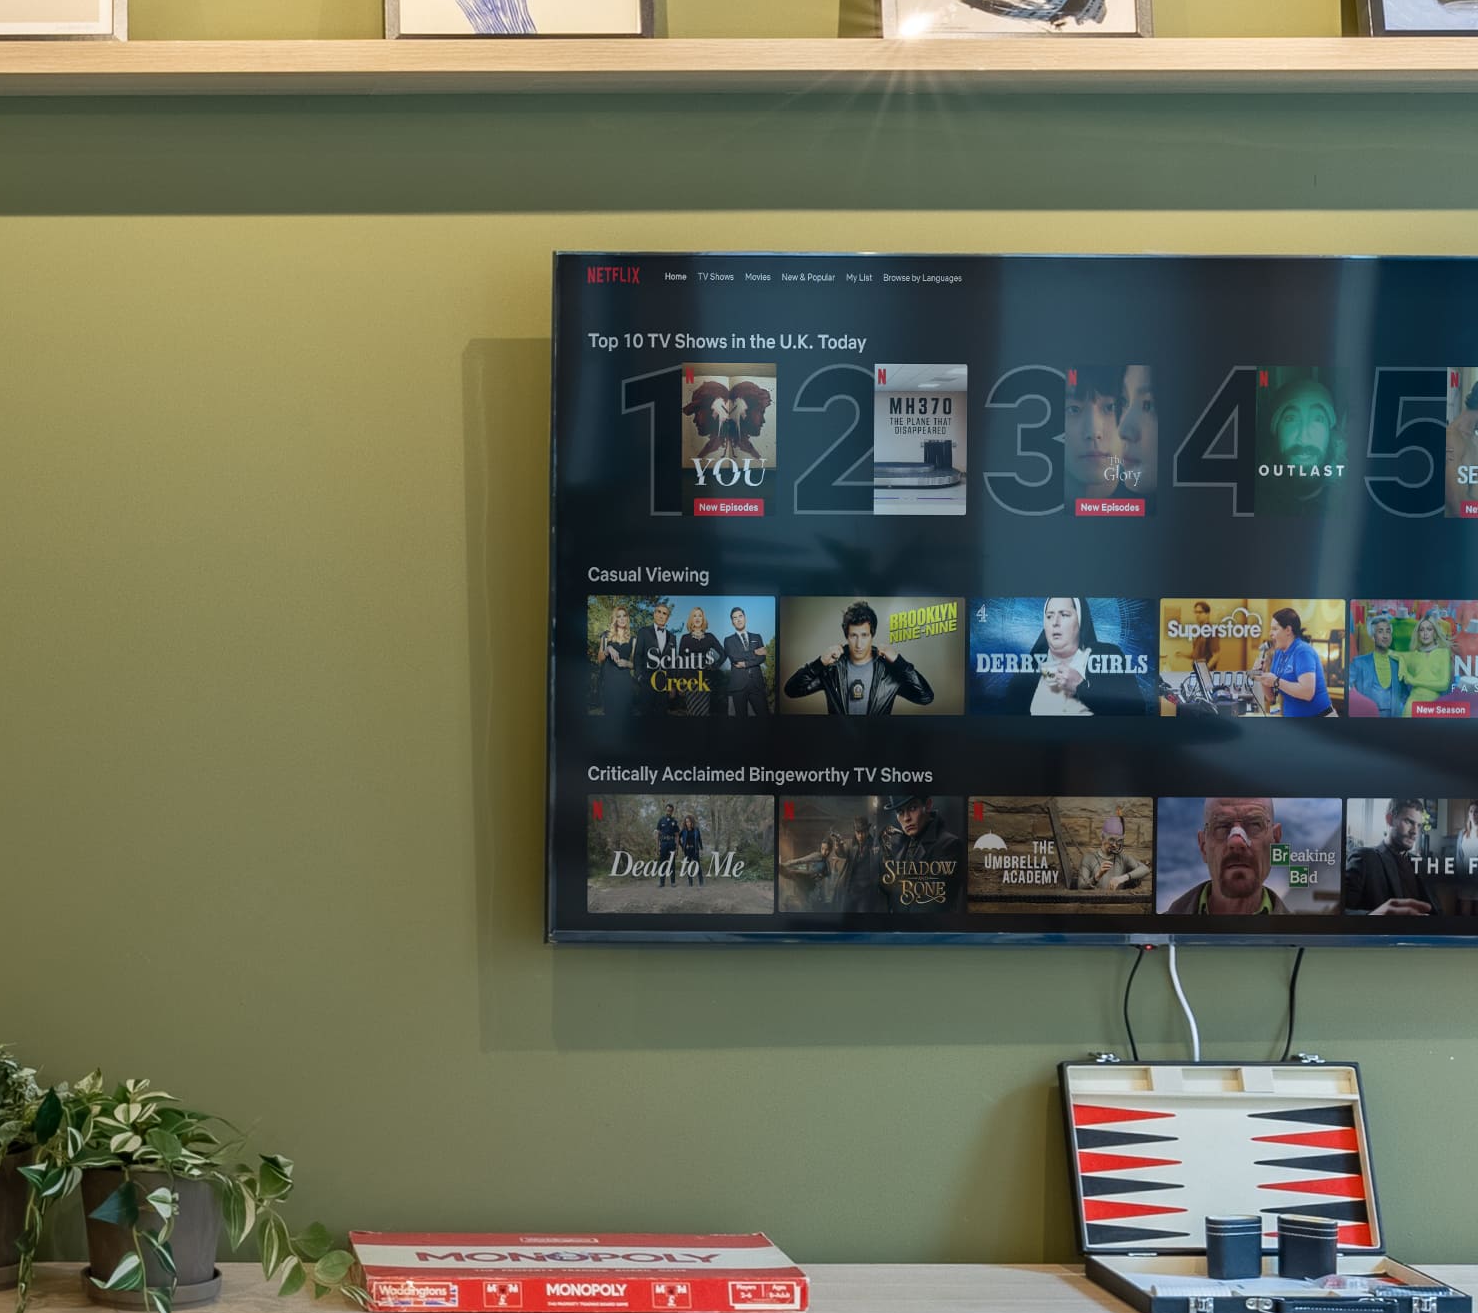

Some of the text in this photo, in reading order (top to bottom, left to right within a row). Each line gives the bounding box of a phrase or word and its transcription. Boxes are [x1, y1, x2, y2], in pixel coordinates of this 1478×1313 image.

[587, 266, 640, 284] NETFLIX
[665, 273, 687, 281] Home
[698, 273, 734, 281] TV Shows
[745, 273, 771, 281] Movies
[781, 273, 836, 283] New & Popular
[846, 273, 872, 283] My List
[883, 273, 962, 285] Browse by Languages
[588, 333, 867, 354] Top 10 TV Shows in the U.K. Today
[889, 397, 952, 415] MH370
[890, 417, 952, 426] THE PLANE THAT
[894, 426, 946, 435] DISAPPEARED
[1109, 455, 1125, 465] The
[690, 457, 768, 486] YOU
[1103, 465, 1142, 486] Glory
[1258, 464, 1345, 477] OUTLAST
[699, 502, 759, 514] New Episodes
[1081, 502, 1140, 513] New Episodes
[588, 566, 710, 587] Casual Viewing
[889, 602, 958, 631] BROOKLYN
[889, 619, 958, 644] NINE-NINE
[1167, 619, 1263, 640] Superstore
[976, 654, 1148, 674] DERRY GIRLS
[650, 670, 711, 692] Creek
[1417, 706, 1466, 714] New Season
[588, 765, 933, 786] Critically Acclaimed Bingeworthy TV Shows
[1032, 840, 1055, 854] THE
[984, 853, 1048, 869] UMBRELLA
[1272, 848, 1336, 865] Breaking
[609, 851, 745, 878] Dead to Me
[882, 859, 957, 885] SHADOW
[1411, 857, 1455, 875] THE
[1002, 870, 1059, 885] ACADEMY
[1290, 870, 1318, 885] Bad
[900, 880, 946, 905] BONE
[414, 1250, 721, 1264] MONOPOLY
[546, 1283, 627, 1296] MONOPOLY
